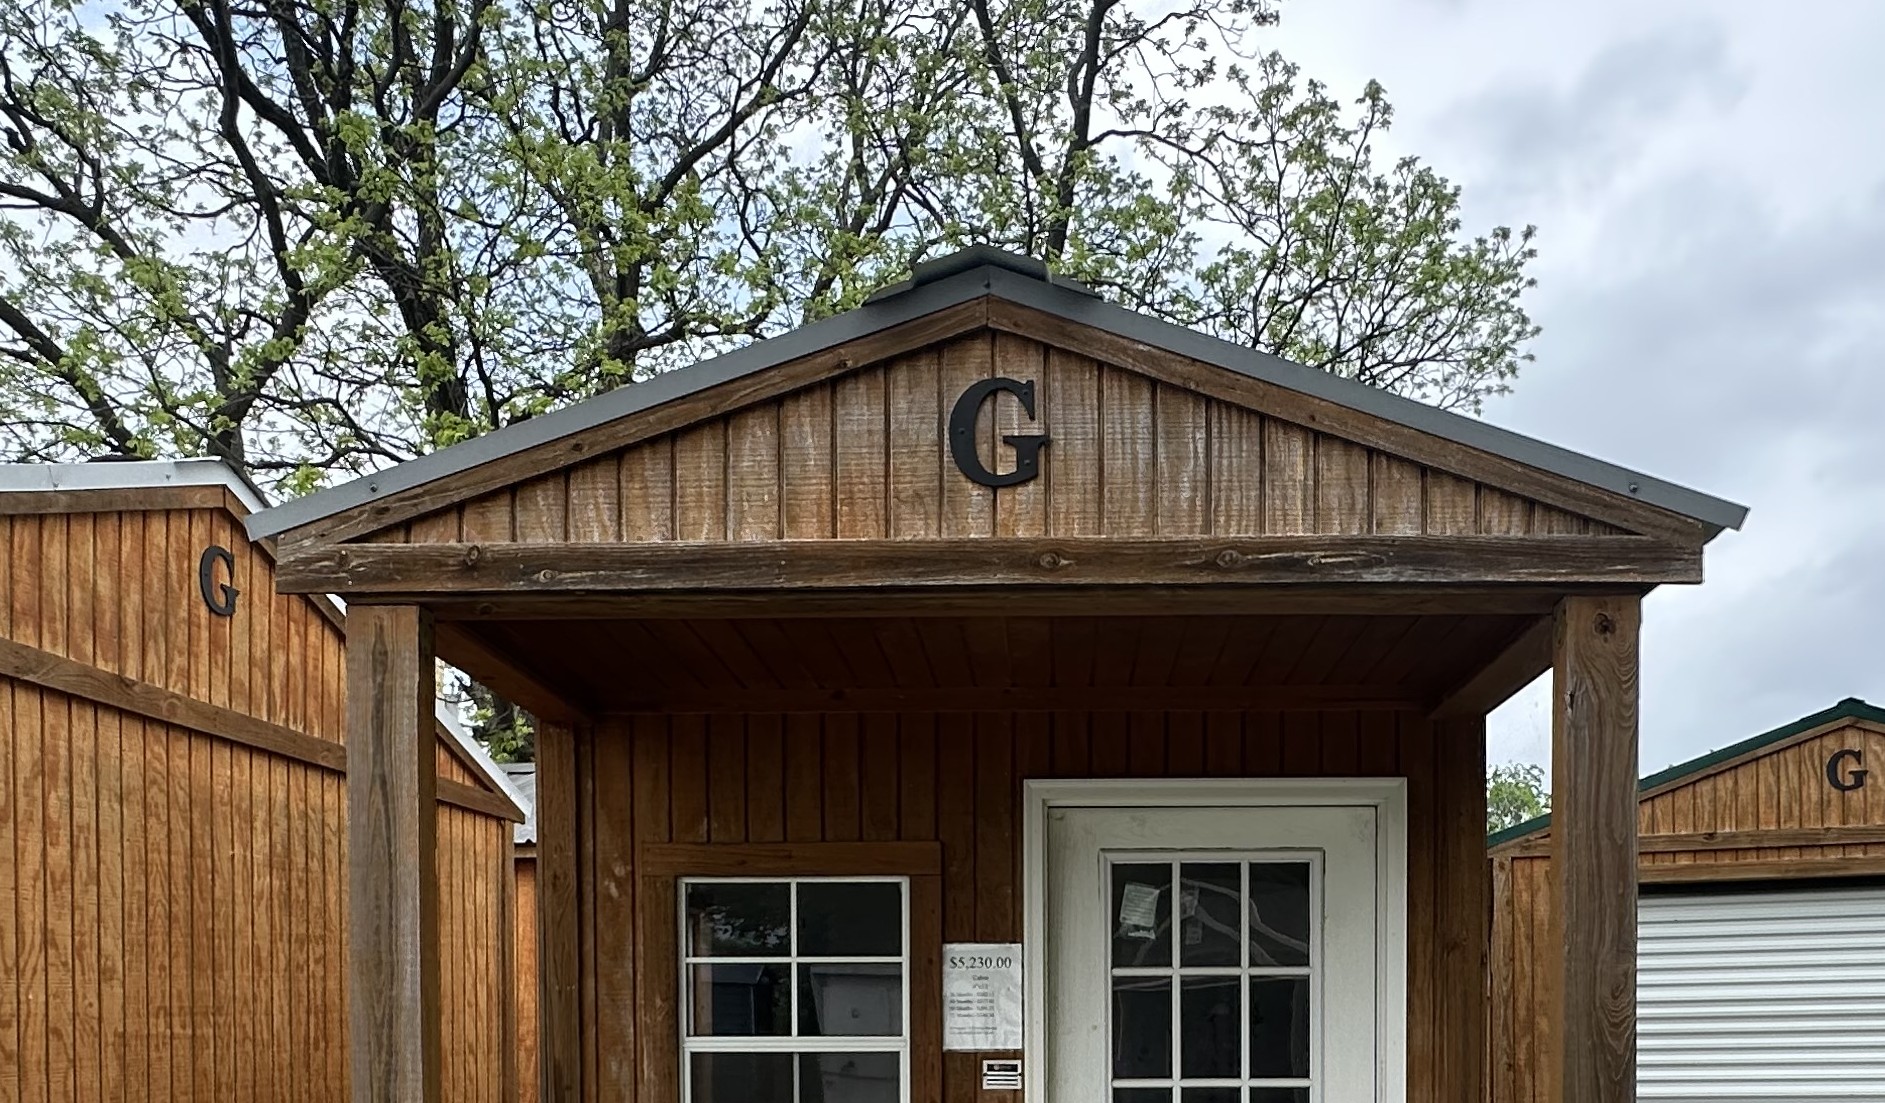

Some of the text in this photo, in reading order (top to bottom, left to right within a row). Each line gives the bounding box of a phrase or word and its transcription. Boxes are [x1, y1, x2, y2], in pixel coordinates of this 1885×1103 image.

[949, 377, 1052, 488] G
[200, 545, 240, 617] G
[1827, 749, 1869, 791] G
[950, 956, 1012, 969] $5,230.00
